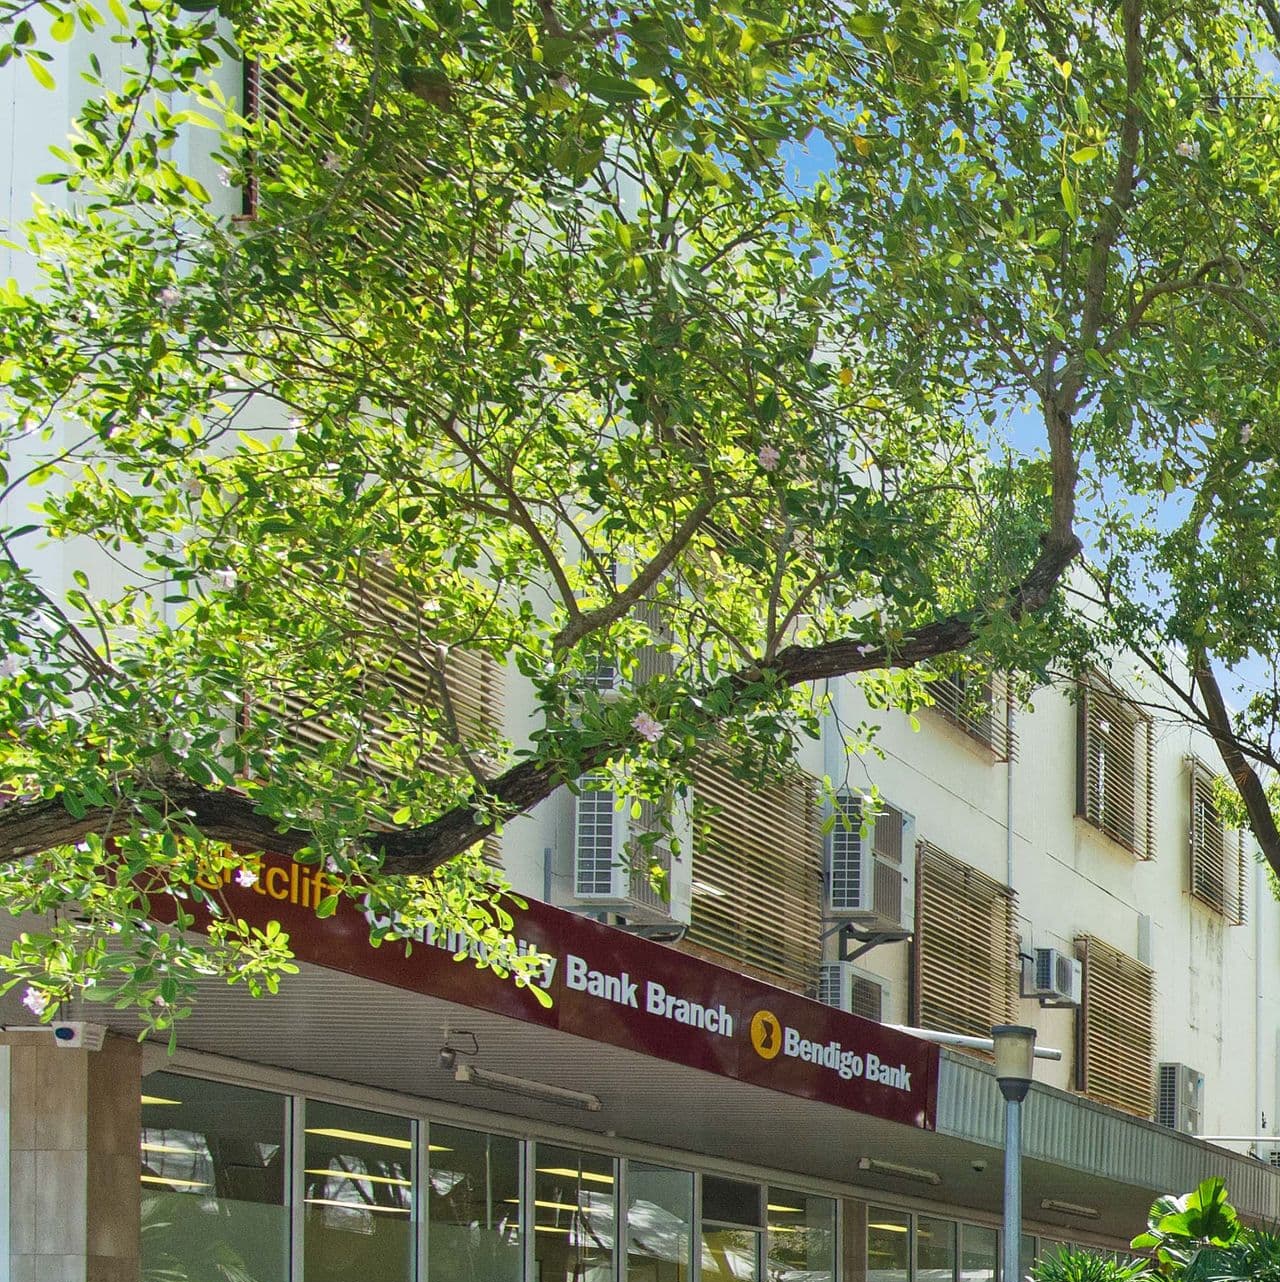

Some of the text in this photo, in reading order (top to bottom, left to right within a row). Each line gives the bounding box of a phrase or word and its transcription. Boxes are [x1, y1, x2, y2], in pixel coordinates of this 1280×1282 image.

[565, 954, 639, 1009] Bank
[646, 981, 733, 1038] Branch
[784, 1027, 911, 1092] Bendigo Bank
